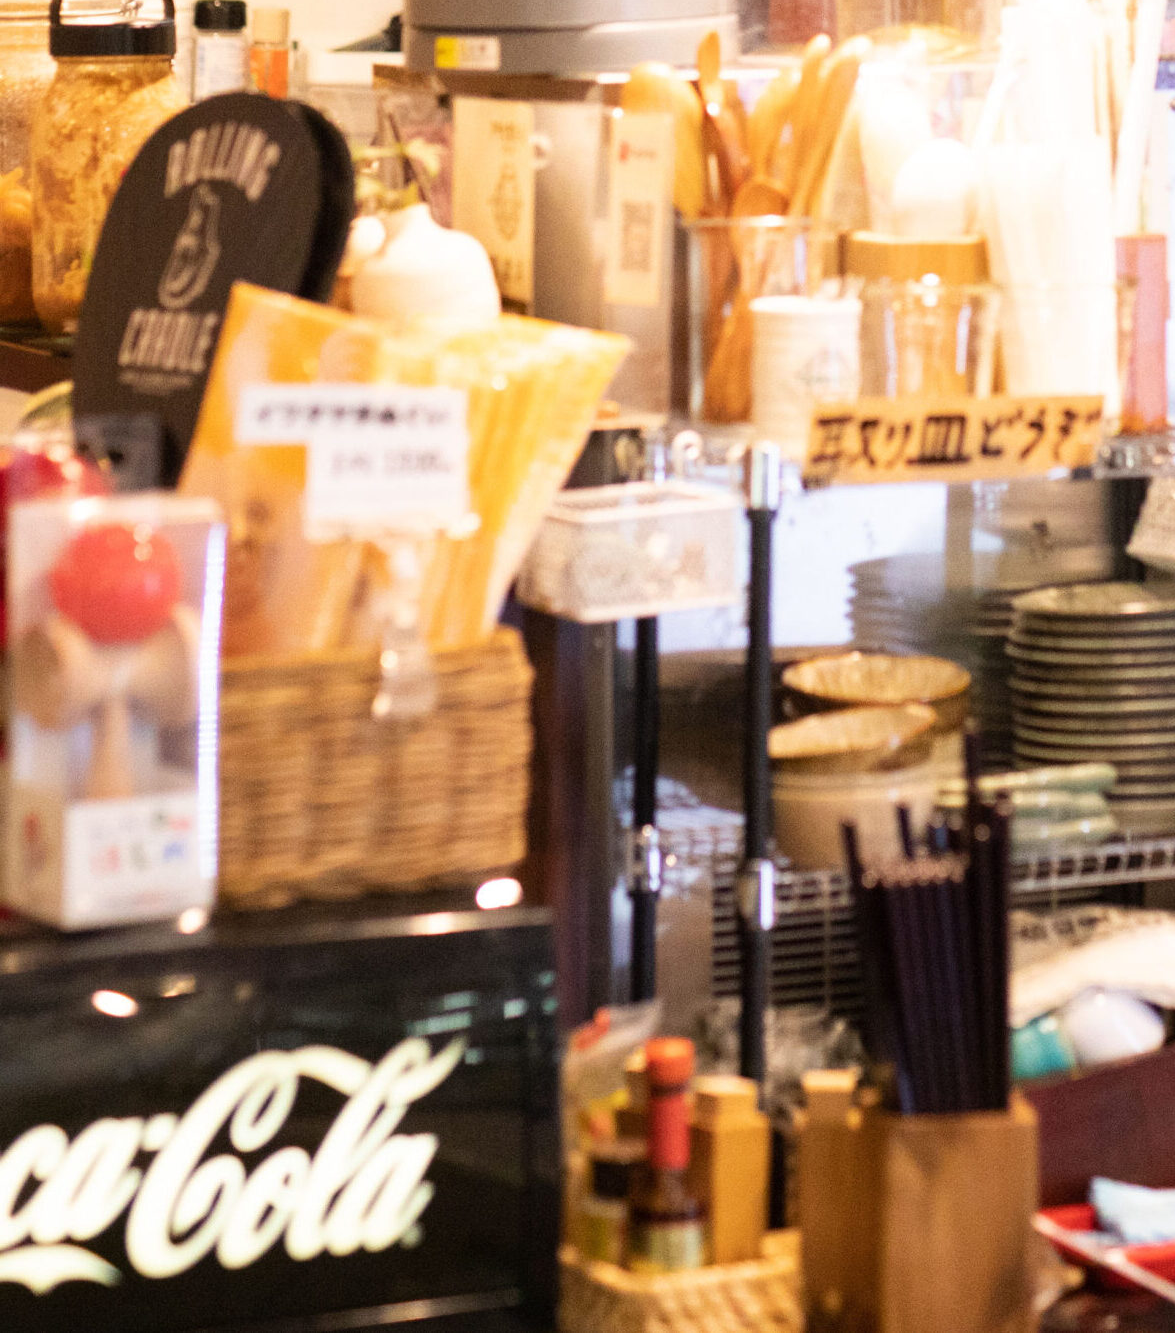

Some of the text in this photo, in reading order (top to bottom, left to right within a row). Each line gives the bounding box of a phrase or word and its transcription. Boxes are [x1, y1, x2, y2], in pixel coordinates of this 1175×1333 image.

[810, 405, 1103, 471] 取り皿どうぞ
